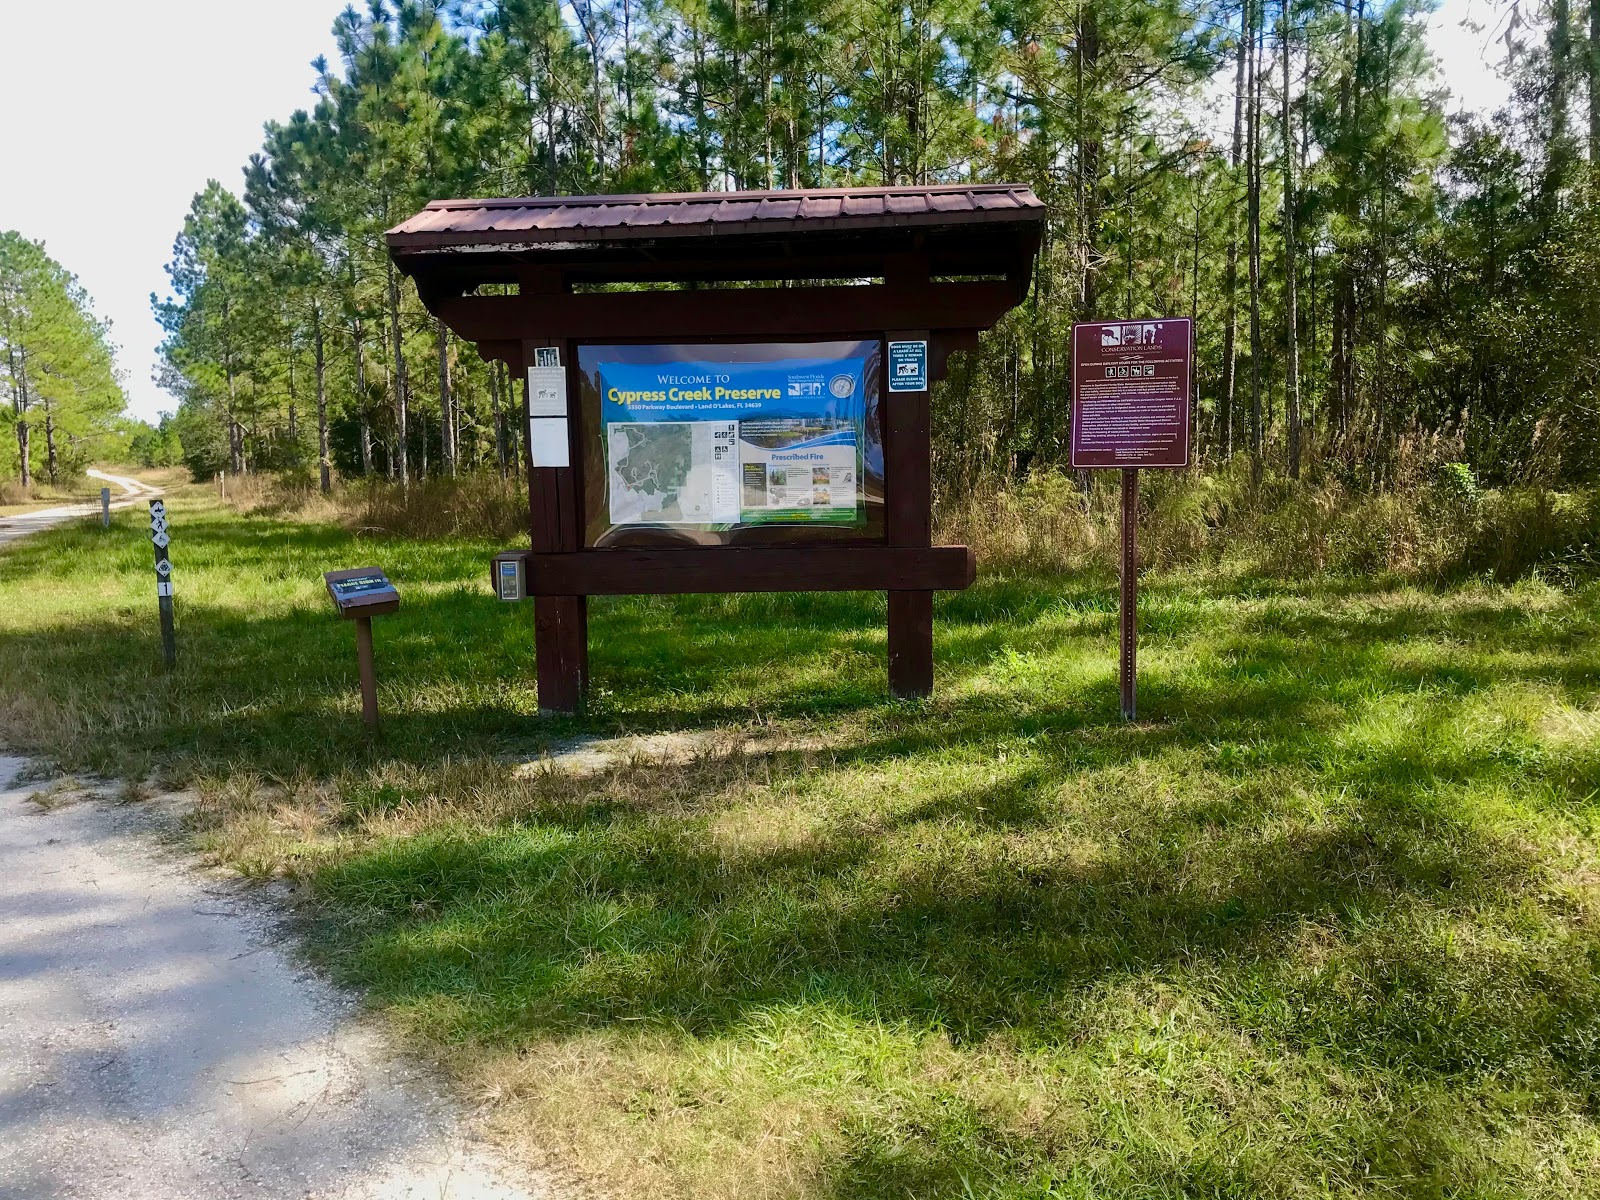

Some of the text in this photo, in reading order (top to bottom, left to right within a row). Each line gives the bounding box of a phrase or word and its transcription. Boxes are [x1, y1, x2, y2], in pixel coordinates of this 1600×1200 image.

[657, 375, 730, 384] WELCOME TO
[608, 387, 781, 405] Cypress Creek Preserve
[163, 582, 168, 595] 1
